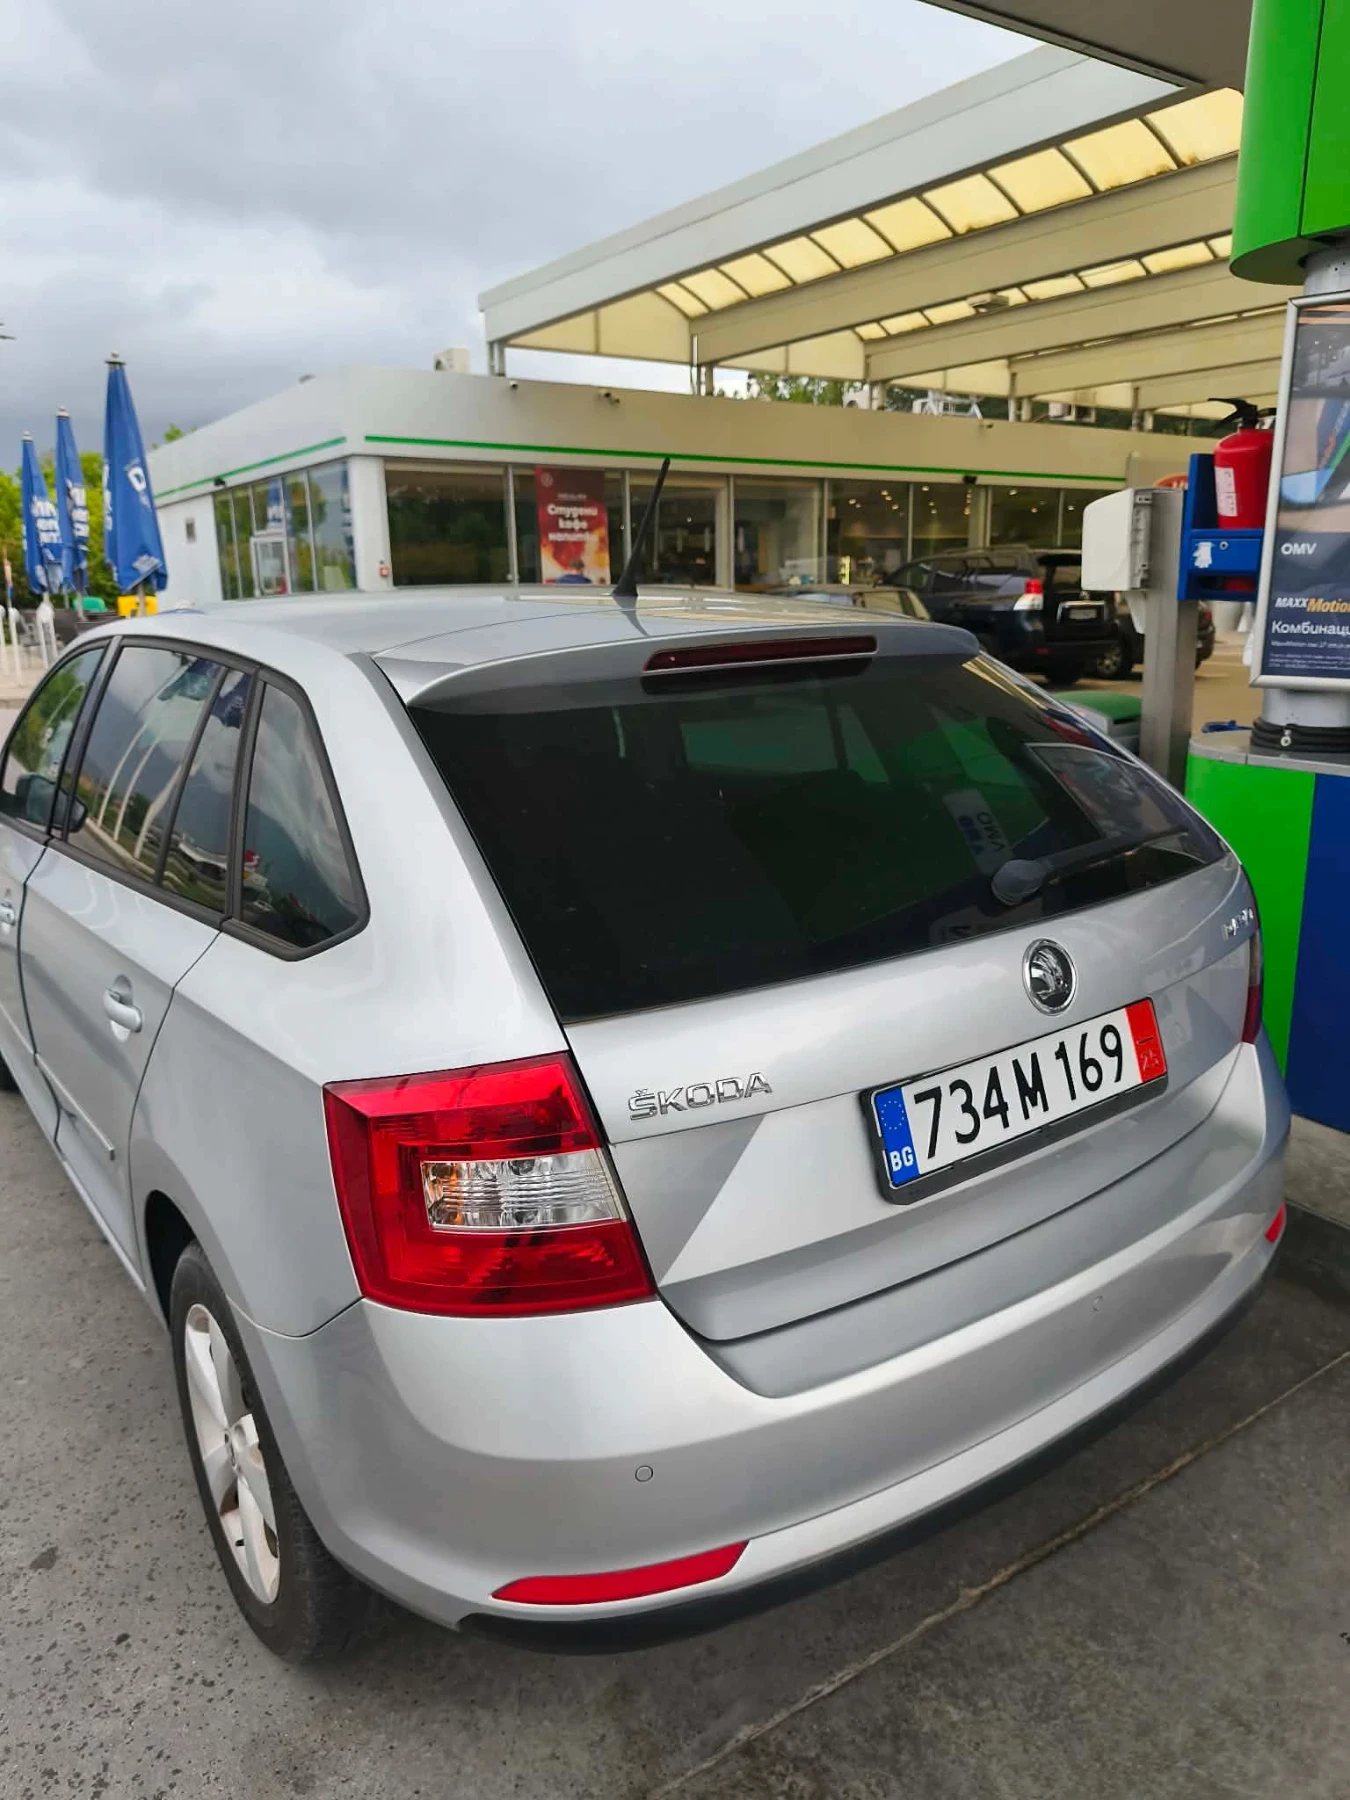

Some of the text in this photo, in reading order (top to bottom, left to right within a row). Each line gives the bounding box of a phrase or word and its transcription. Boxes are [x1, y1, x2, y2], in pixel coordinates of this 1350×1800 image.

[1280, 543, 1317, 555] OMV
[1275, 597, 1350, 613] MAXXMotio
[628, 1071, 773, 1121] ŠKODA
[914, 1024, 1124, 1160] 734 M 169
[889, 1145, 914, 1172] BG
